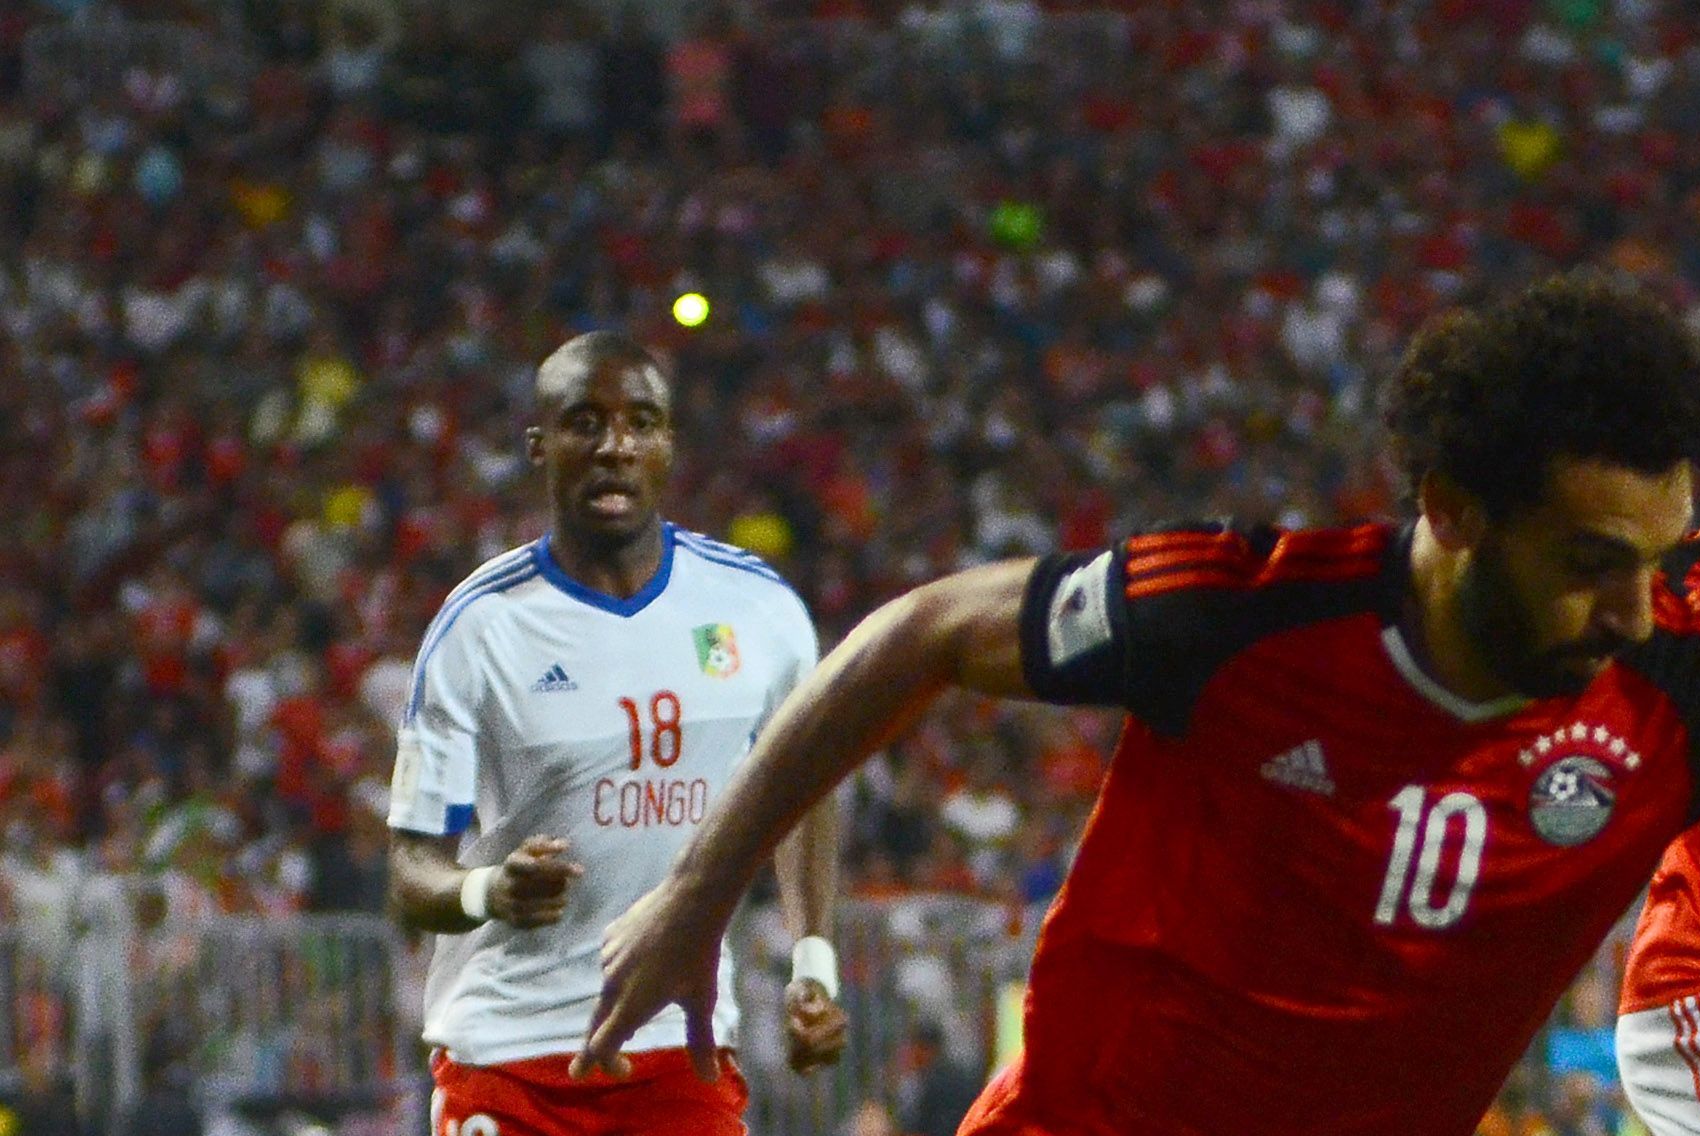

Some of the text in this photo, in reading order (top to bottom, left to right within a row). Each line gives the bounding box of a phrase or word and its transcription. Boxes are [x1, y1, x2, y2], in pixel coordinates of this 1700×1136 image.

[619, 690, 681, 770] 18
[594, 777, 706, 826] CONGO
[1374, 783, 1487, 929] 10
